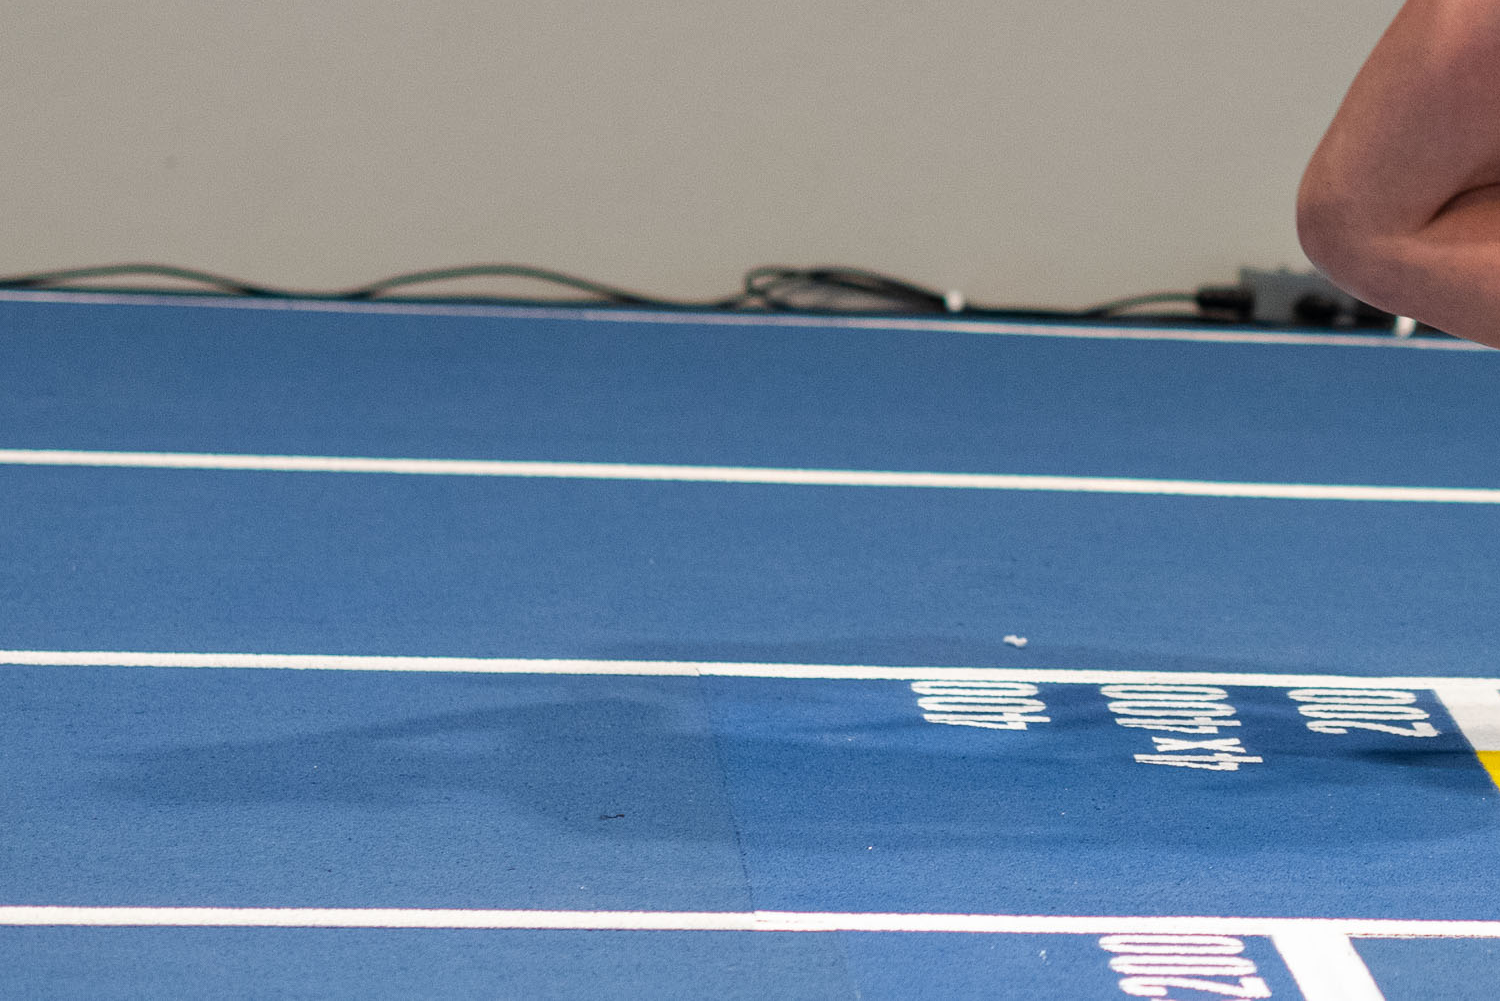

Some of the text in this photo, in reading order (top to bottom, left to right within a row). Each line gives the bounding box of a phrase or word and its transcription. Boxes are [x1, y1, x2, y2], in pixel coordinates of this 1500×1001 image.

[910, 680, 1050, 731] 400
[1100, 683, 1263, 771] 4x400
[1289, 688, 1441, 738] 200
